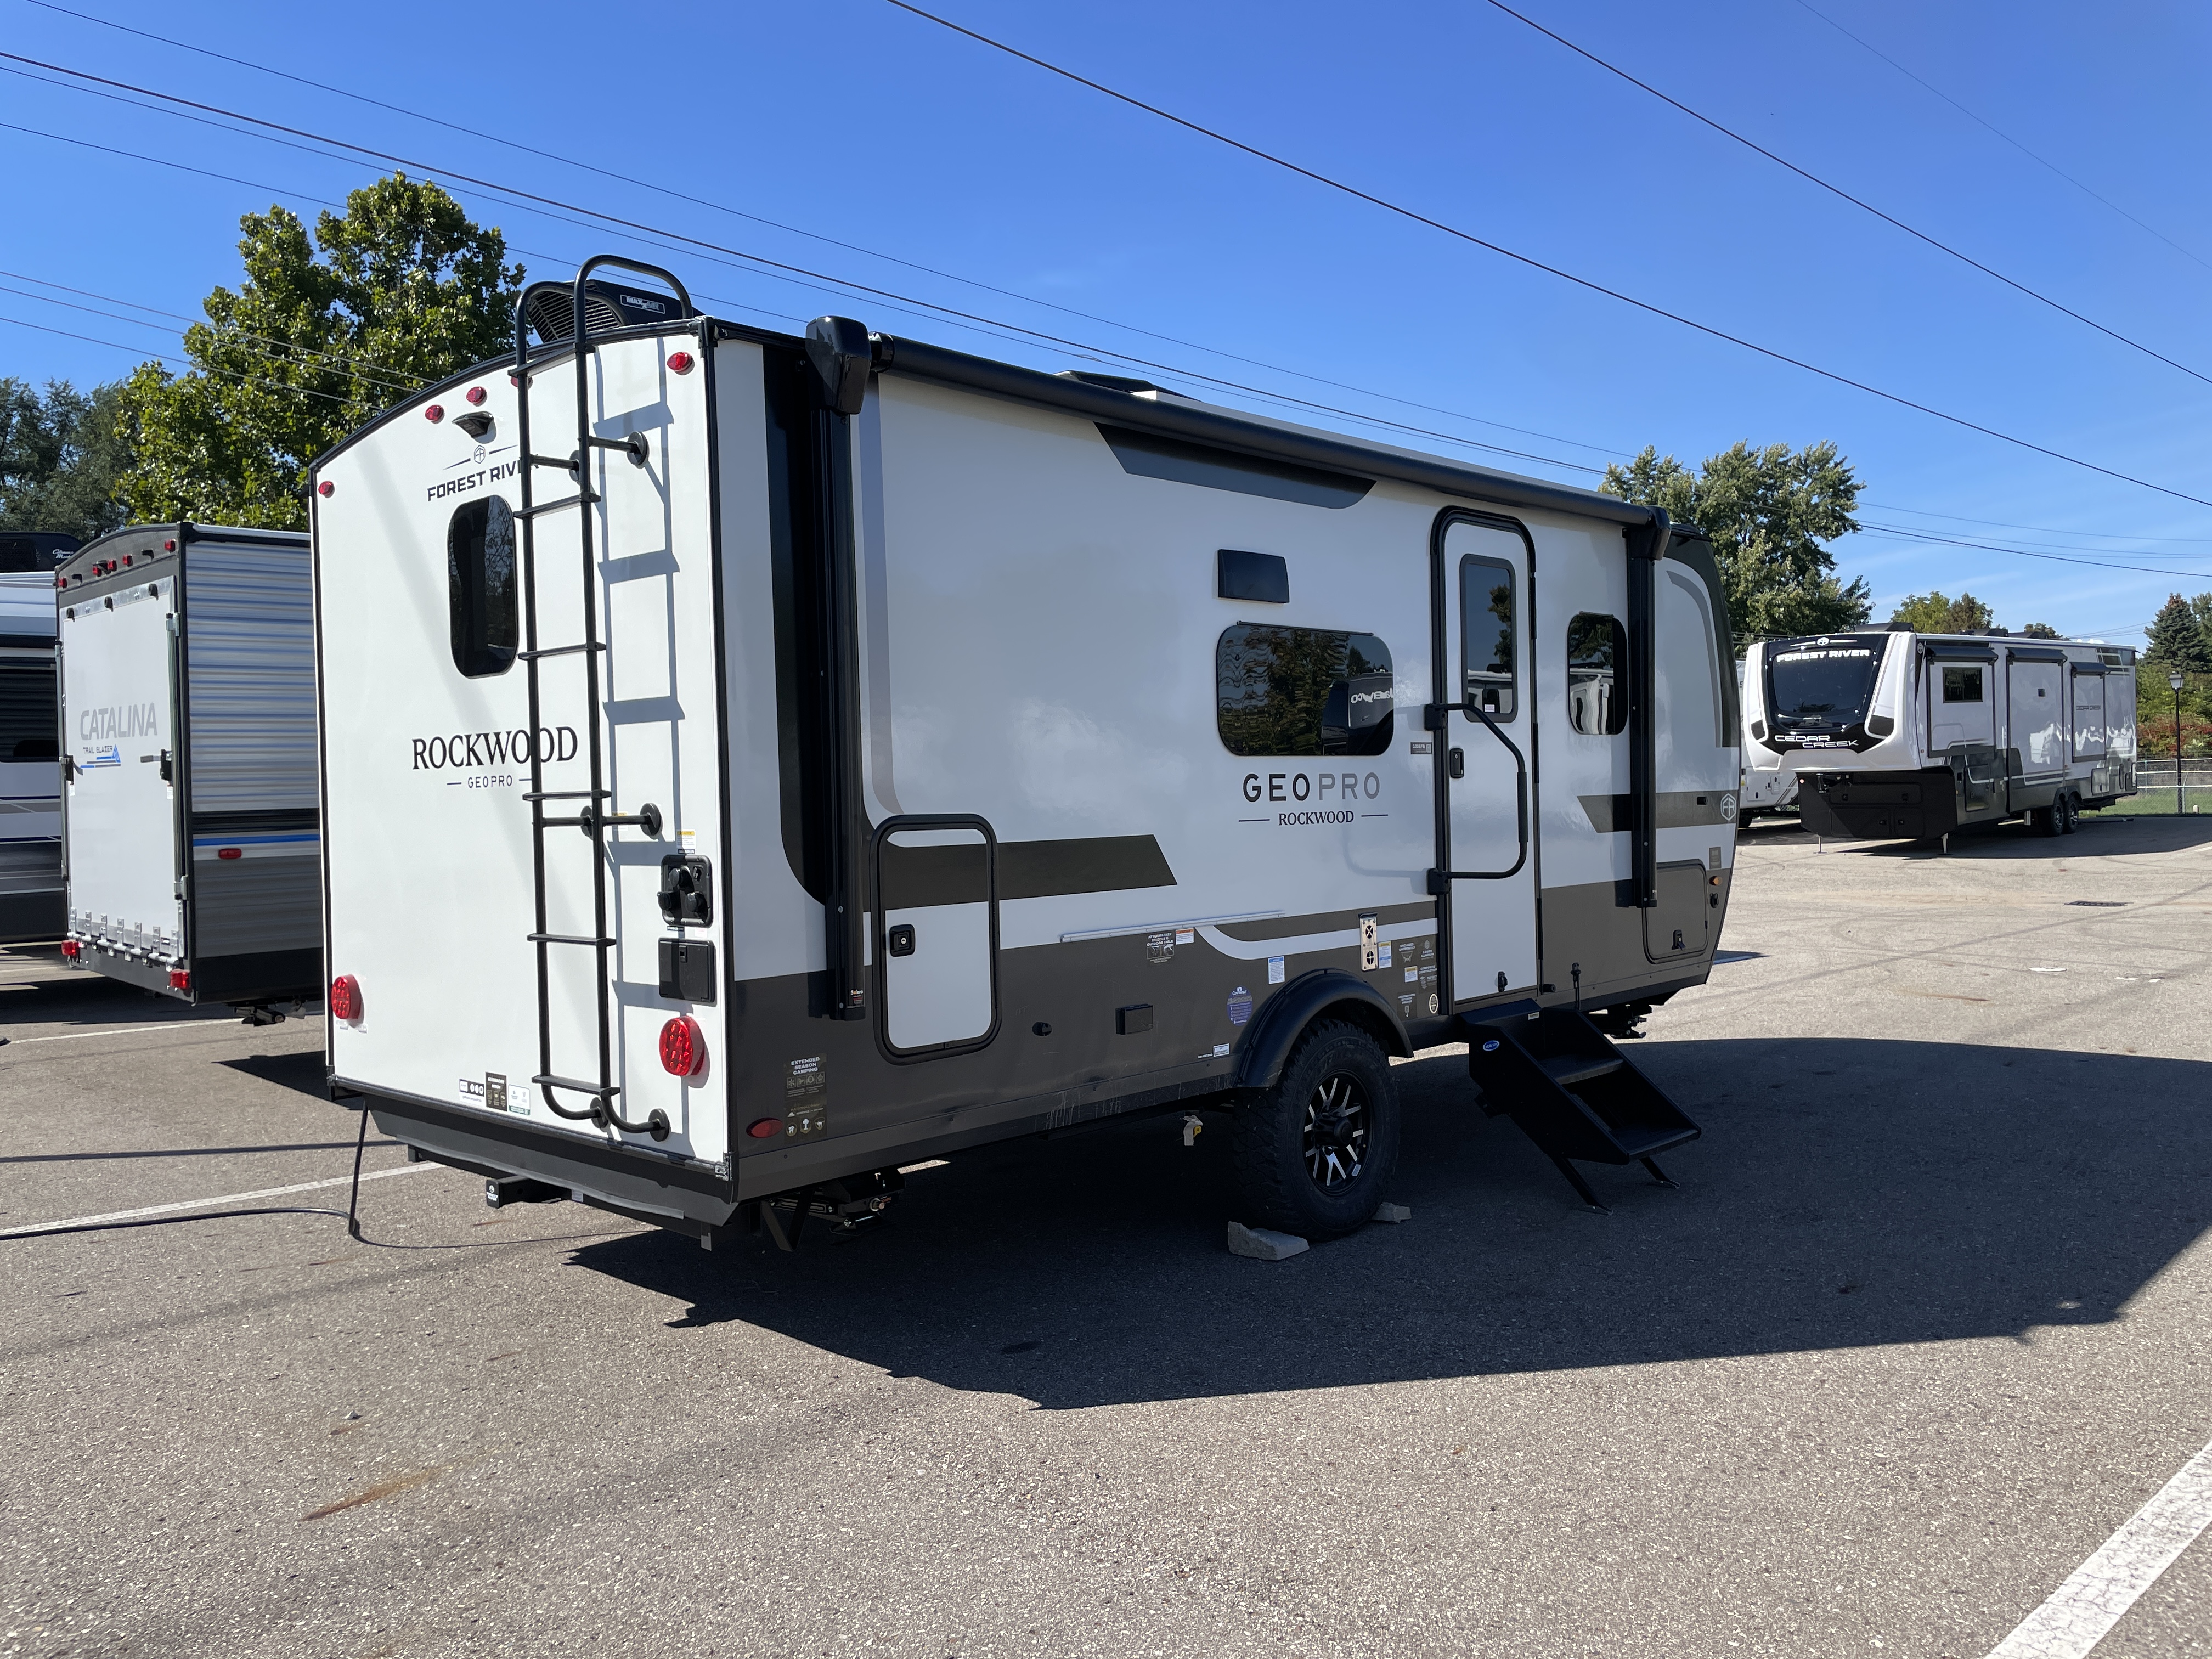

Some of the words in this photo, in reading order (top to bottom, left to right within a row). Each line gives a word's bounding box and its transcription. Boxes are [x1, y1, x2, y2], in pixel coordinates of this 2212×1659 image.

[427, 471, 486, 501] FOREST
[490, 460, 532, 483] RIV
[1776, 651, 1827, 662] FOREST
[1829, 649, 1870, 658] RIVER
[80, 702, 157, 741] CATALINA
[412, 726, 578, 770] ROCKWOOD
[1802, 740, 1859, 748] CREEK
[468, 775, 512, 788] GEOPRO
[1278, 811, 1354, 826] ROCKWOOD
[791, 1057, 820, 1065] EXTENDED
[793, 1067, 818, 1075] CAMPING
